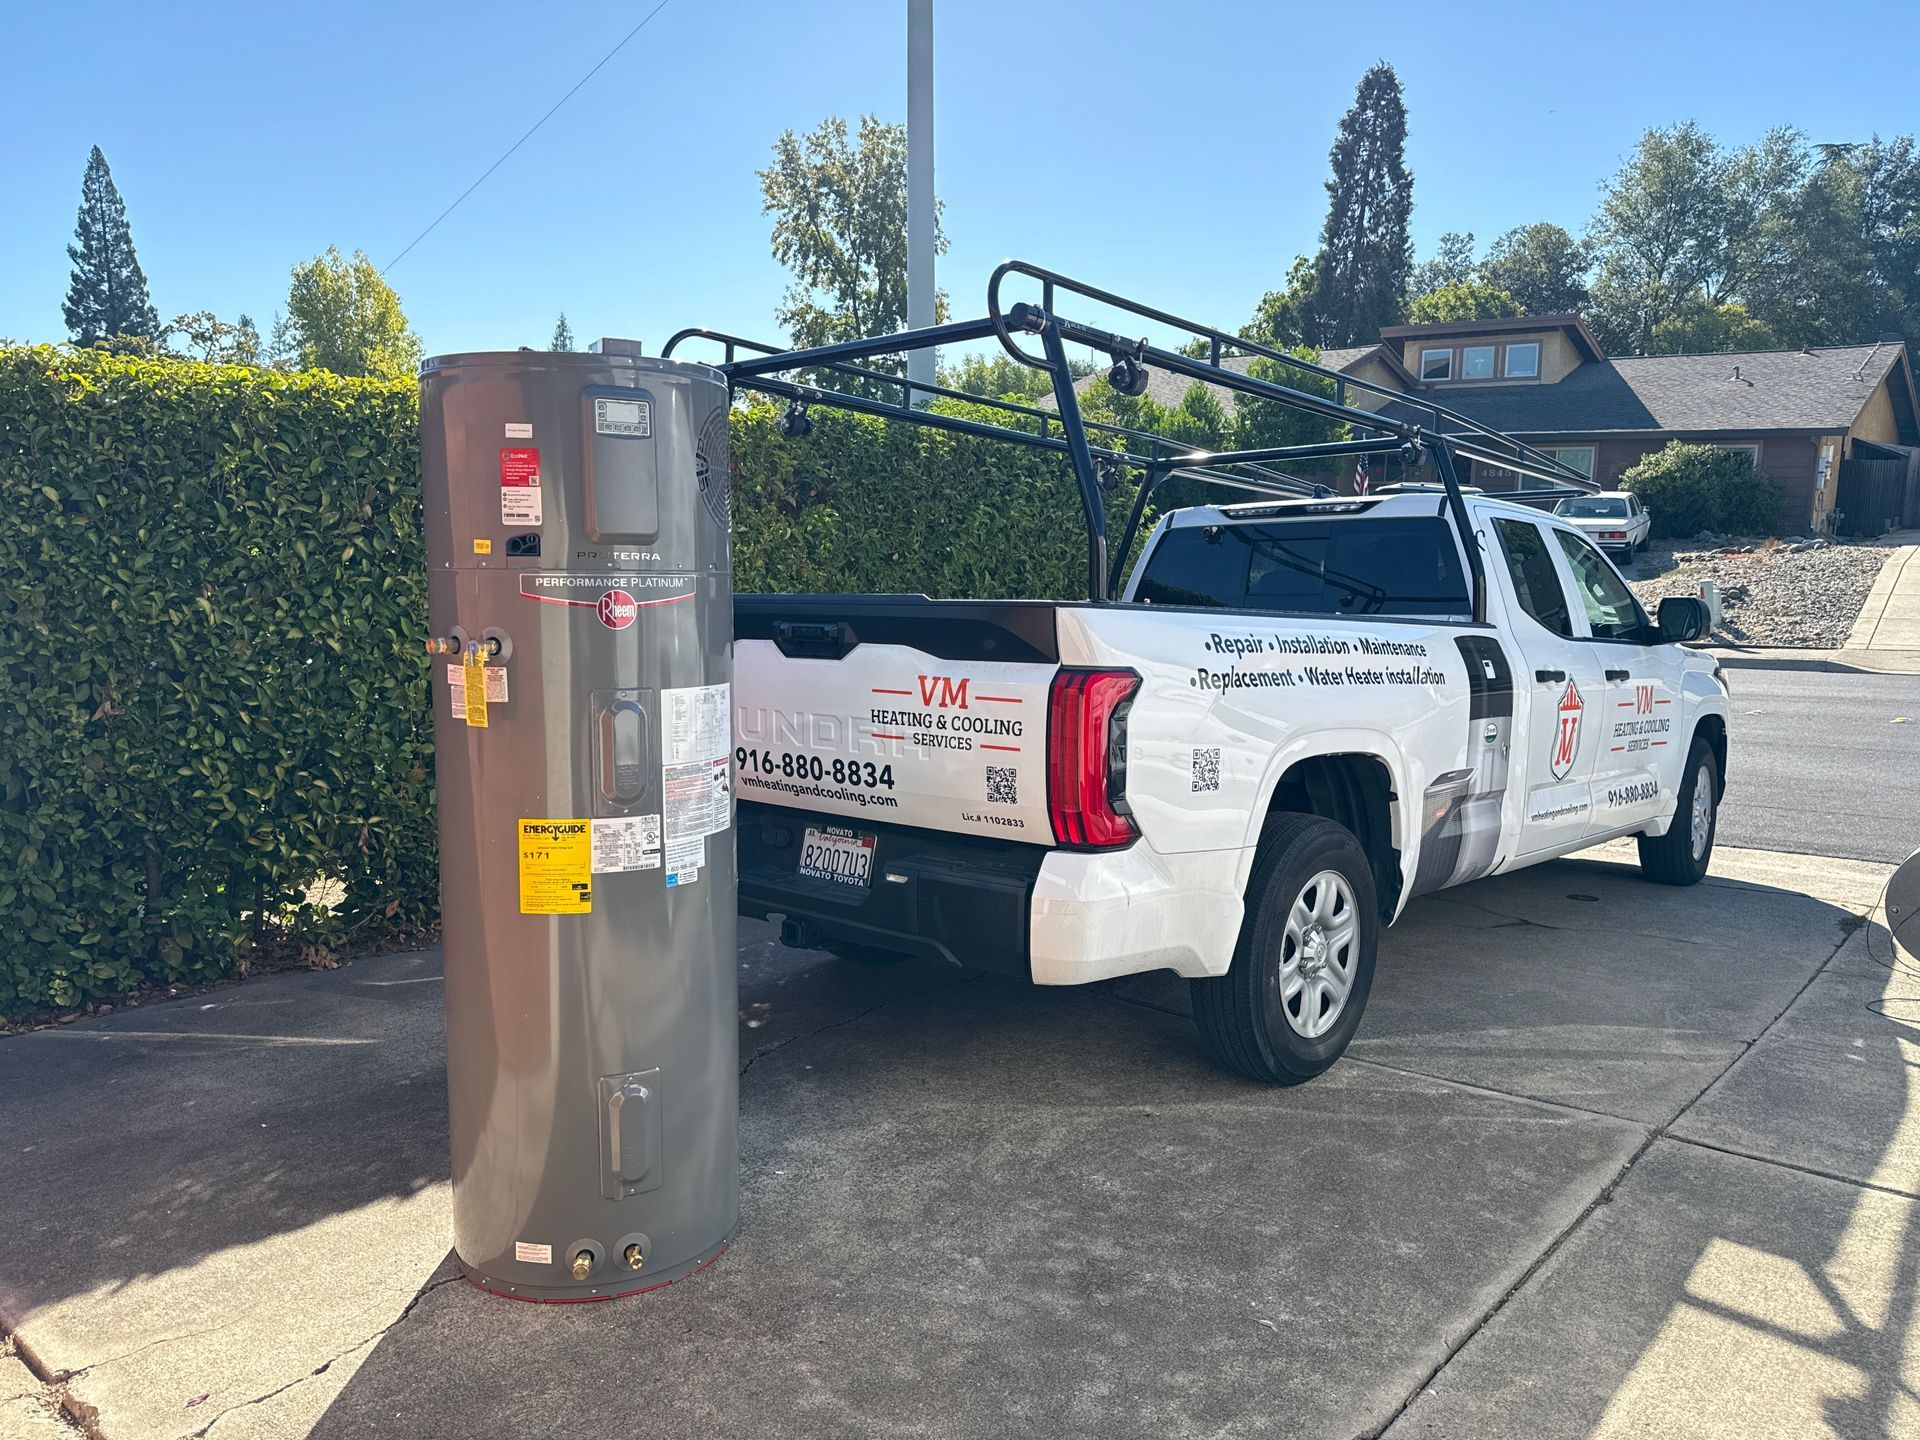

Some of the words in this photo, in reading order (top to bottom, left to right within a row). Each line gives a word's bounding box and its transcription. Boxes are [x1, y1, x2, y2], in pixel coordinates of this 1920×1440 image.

[1480, 468, 1512, 478] 4845
[535, 577, 628, 588] PERFORMANCE
[602, 591, 635, 622] Rheem
[1210, 633, 1263, 660] Repair
[1275, 634, 1350, 655] Installation
[1358, 637, 1427, 657] Maintenance
[1197, 665, 1296, 695] Replacement
[1304, 666, 1343, 686] Water
[1344, 666, 1384, 685] Heater
[1385, 665, 1446, 686] installation
[917, 675, 970, 710] VM
[1636, 685, 1654, 715] VM
[871, 708, 933, 730] HEATING
[937, 715, 947, 730] &
[951, 716, 1023, 737] COOLING
[1613, 721, 1638, 738] HEATING
[1643, 718, 1670, 734] COOLING
[913, 732, 972, 751] SERVICES
[1627, 738, 1650, 752] SERVICES
[735, 747, 895, 791] 916-880-8834
[741, 775, 898, 808] vmheatingandcooling.com
[1608, 780, 1659, 808] 916-880-8834
[984, 814, 1025, 828] 1102833
[1531, 803, 1588, 822] vmheatingandcooling.com
[523, 824, 586, 835] ENERGYGUIDE
[826, 826, 853, 837] NOVATO
[818, 833, 858, 847] California
[804, 844, 868, 878] 82007U3
[799, 867, 832, 880] NOVATO
[833, 874, 864, 887] TOYOTA
